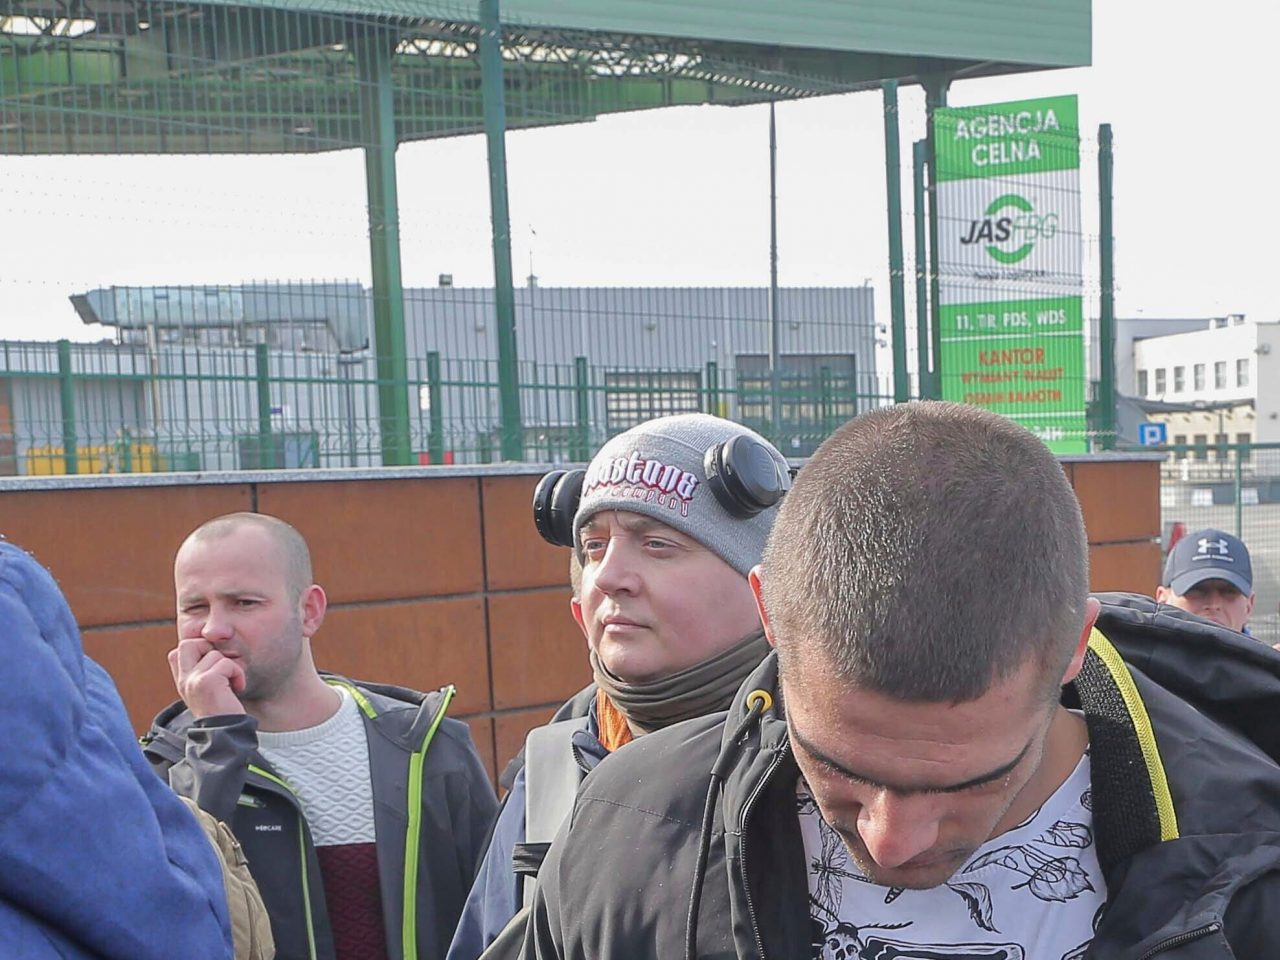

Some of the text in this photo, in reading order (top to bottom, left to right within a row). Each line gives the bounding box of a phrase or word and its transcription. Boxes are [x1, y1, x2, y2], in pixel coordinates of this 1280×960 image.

[955, 109, 1060, 140] AGENCJA
[971, 138, 1041, 167] CELNA
[978, 347, 1045, 366] KANTOR
